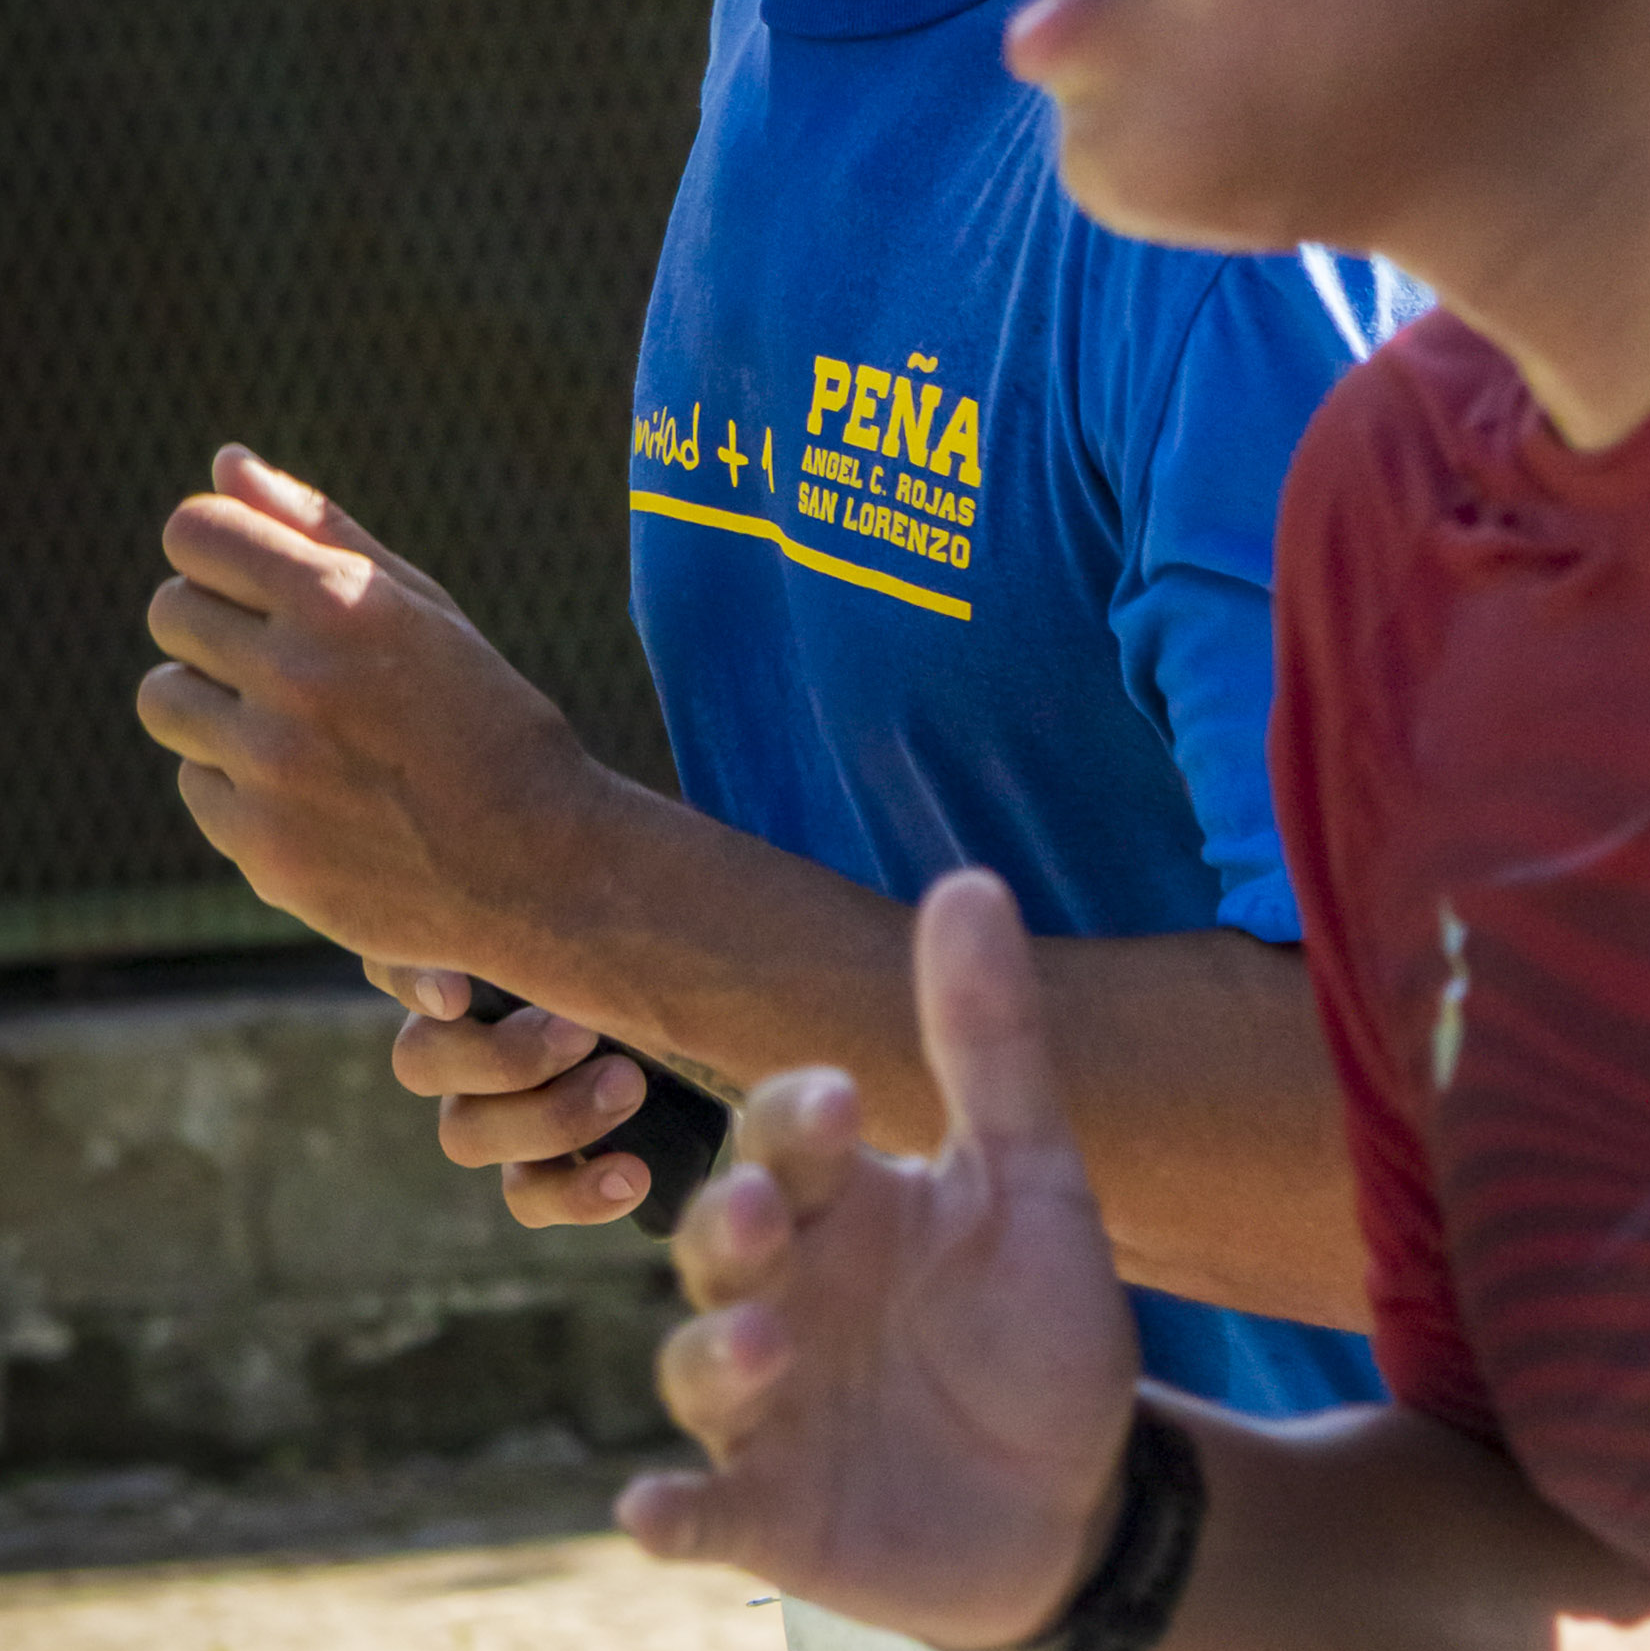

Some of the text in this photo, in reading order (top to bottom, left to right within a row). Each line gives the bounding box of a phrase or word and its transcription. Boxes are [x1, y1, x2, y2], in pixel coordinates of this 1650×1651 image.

[806, 352, 981, 488] PEÑA
[798, 481, 971, 569] SAN LORENZO
[801, 445, 976, 527] ANGEL C. ROJAS
